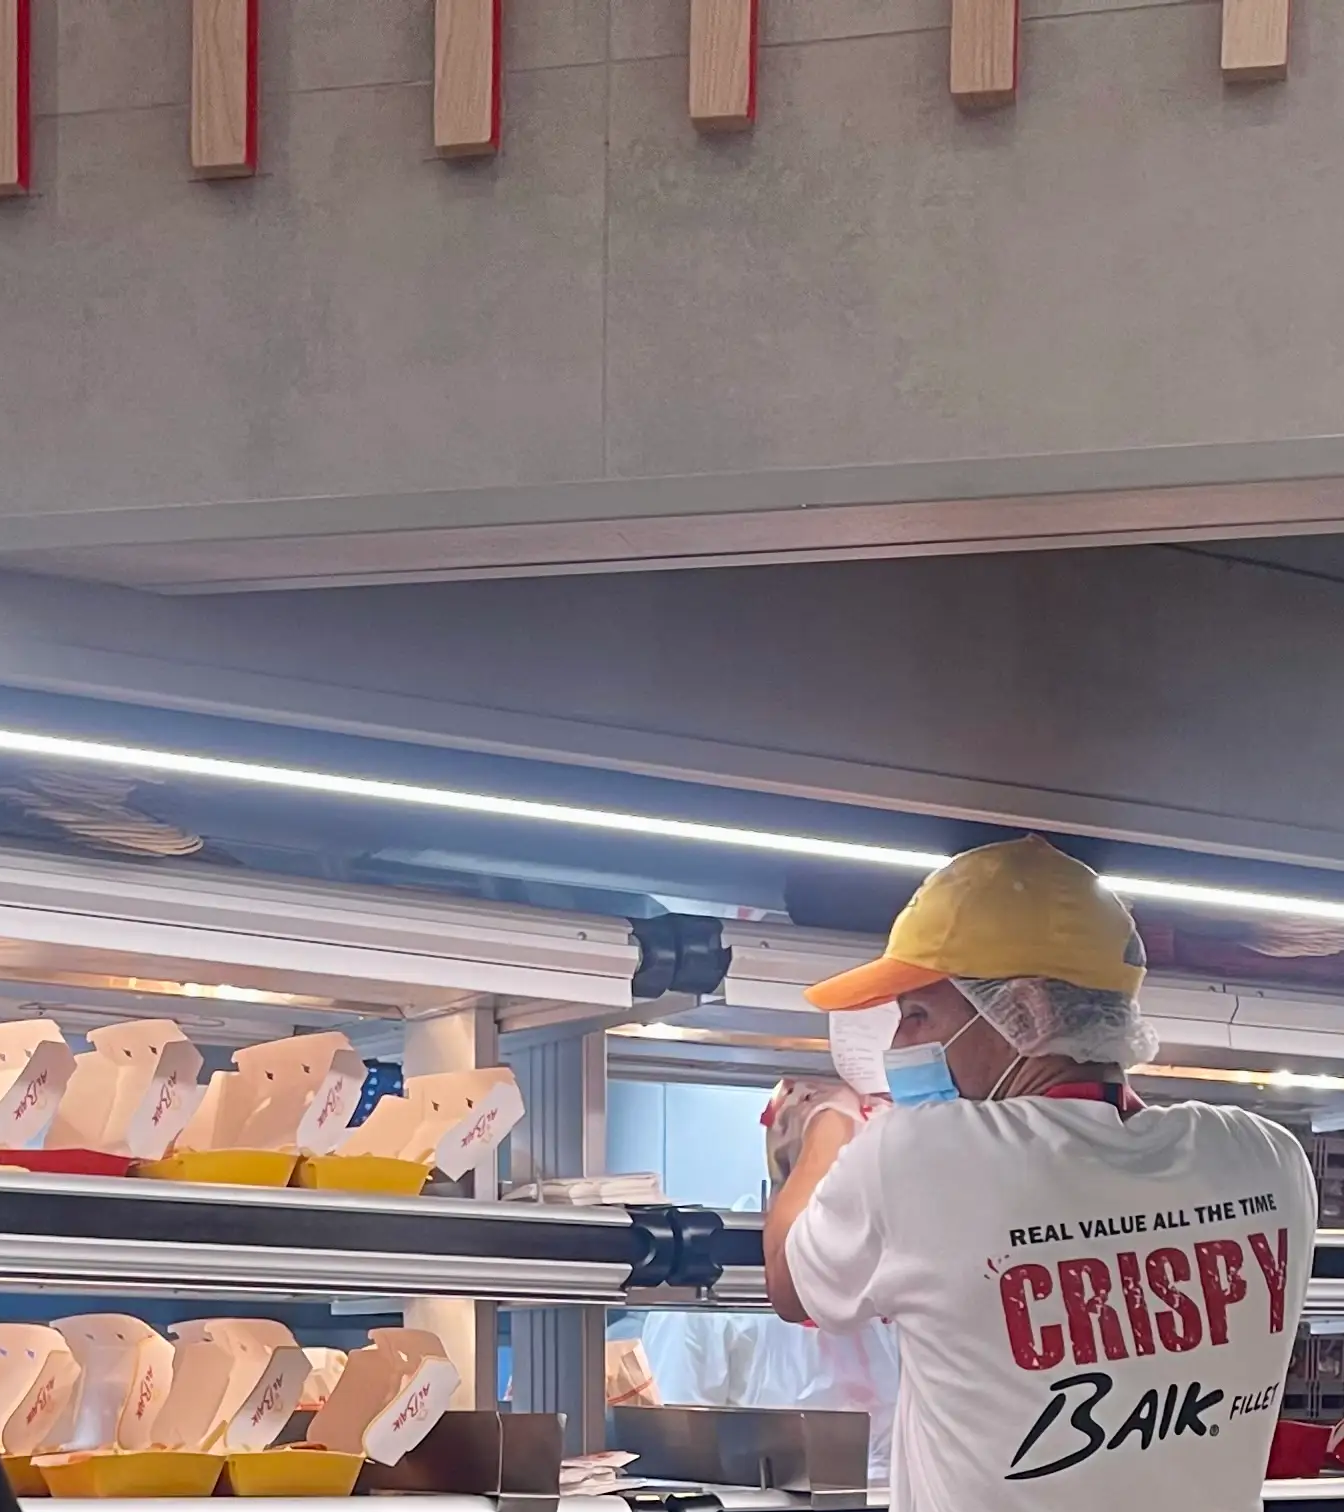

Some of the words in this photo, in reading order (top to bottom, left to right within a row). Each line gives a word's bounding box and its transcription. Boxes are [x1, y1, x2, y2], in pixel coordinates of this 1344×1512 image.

[1009, 1222, 1074, 1247] REAL
[1078, 1214, 1147, 1239] VALUE
[1153, 1209, 1191, 1231] ALL
[1194, 1201, 1236, 1225] THE
[1238, 1192, 1277, 1215] TIME
[998, 1228, 1289, 1371] CRISPY
[1229, 1382, 1279, 1420] FILLET
